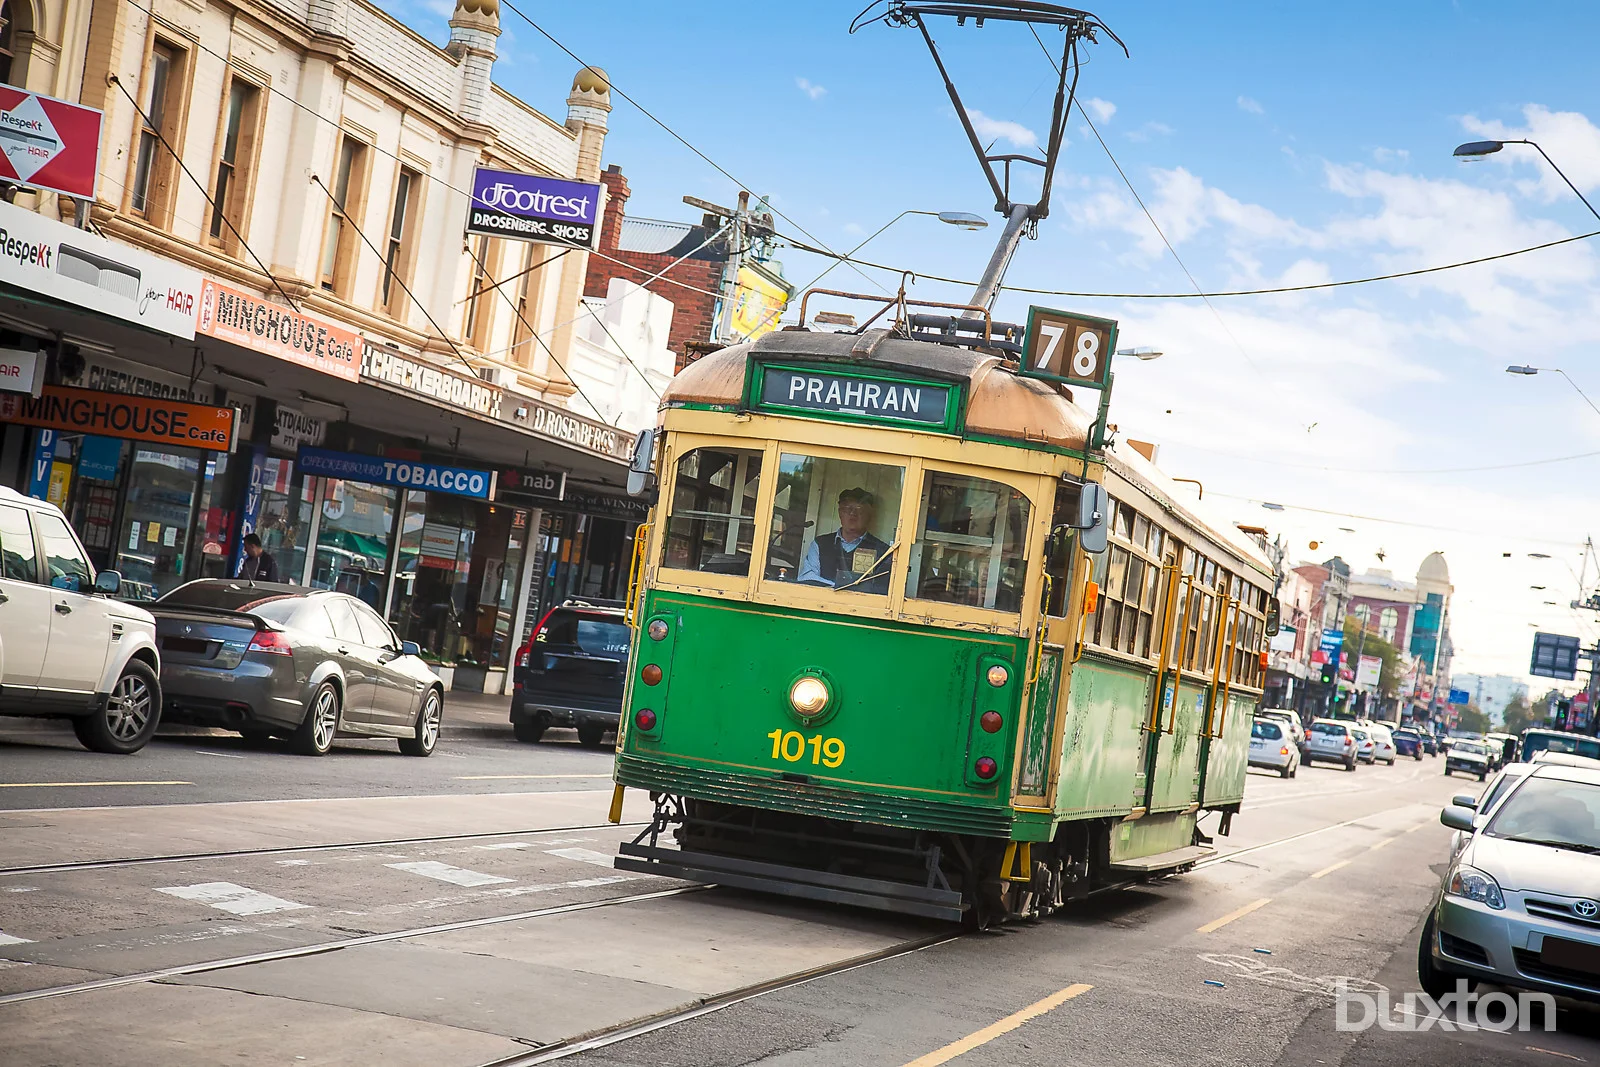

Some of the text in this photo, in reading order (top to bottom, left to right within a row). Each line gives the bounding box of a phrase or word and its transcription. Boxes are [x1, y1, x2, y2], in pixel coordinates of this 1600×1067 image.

[481, 182, 590, 219] Footrest
[473, 212, 590, 242] D.ROSENBERG SHOES
[216, 291, 329, 359] MINGHOUSE
[1036, 324, 1100, 377] 78
[369, 351, 491, 414] CHECKERBOARD
[788, 375, 921, 413] PRAHRAN
[20, 388, 188, 440] MINGHOUSE
[384, 461, 484, 494] TOBACCO
[523, 474, 556, 491] nab
[767, 728, 846, 768] 1019
